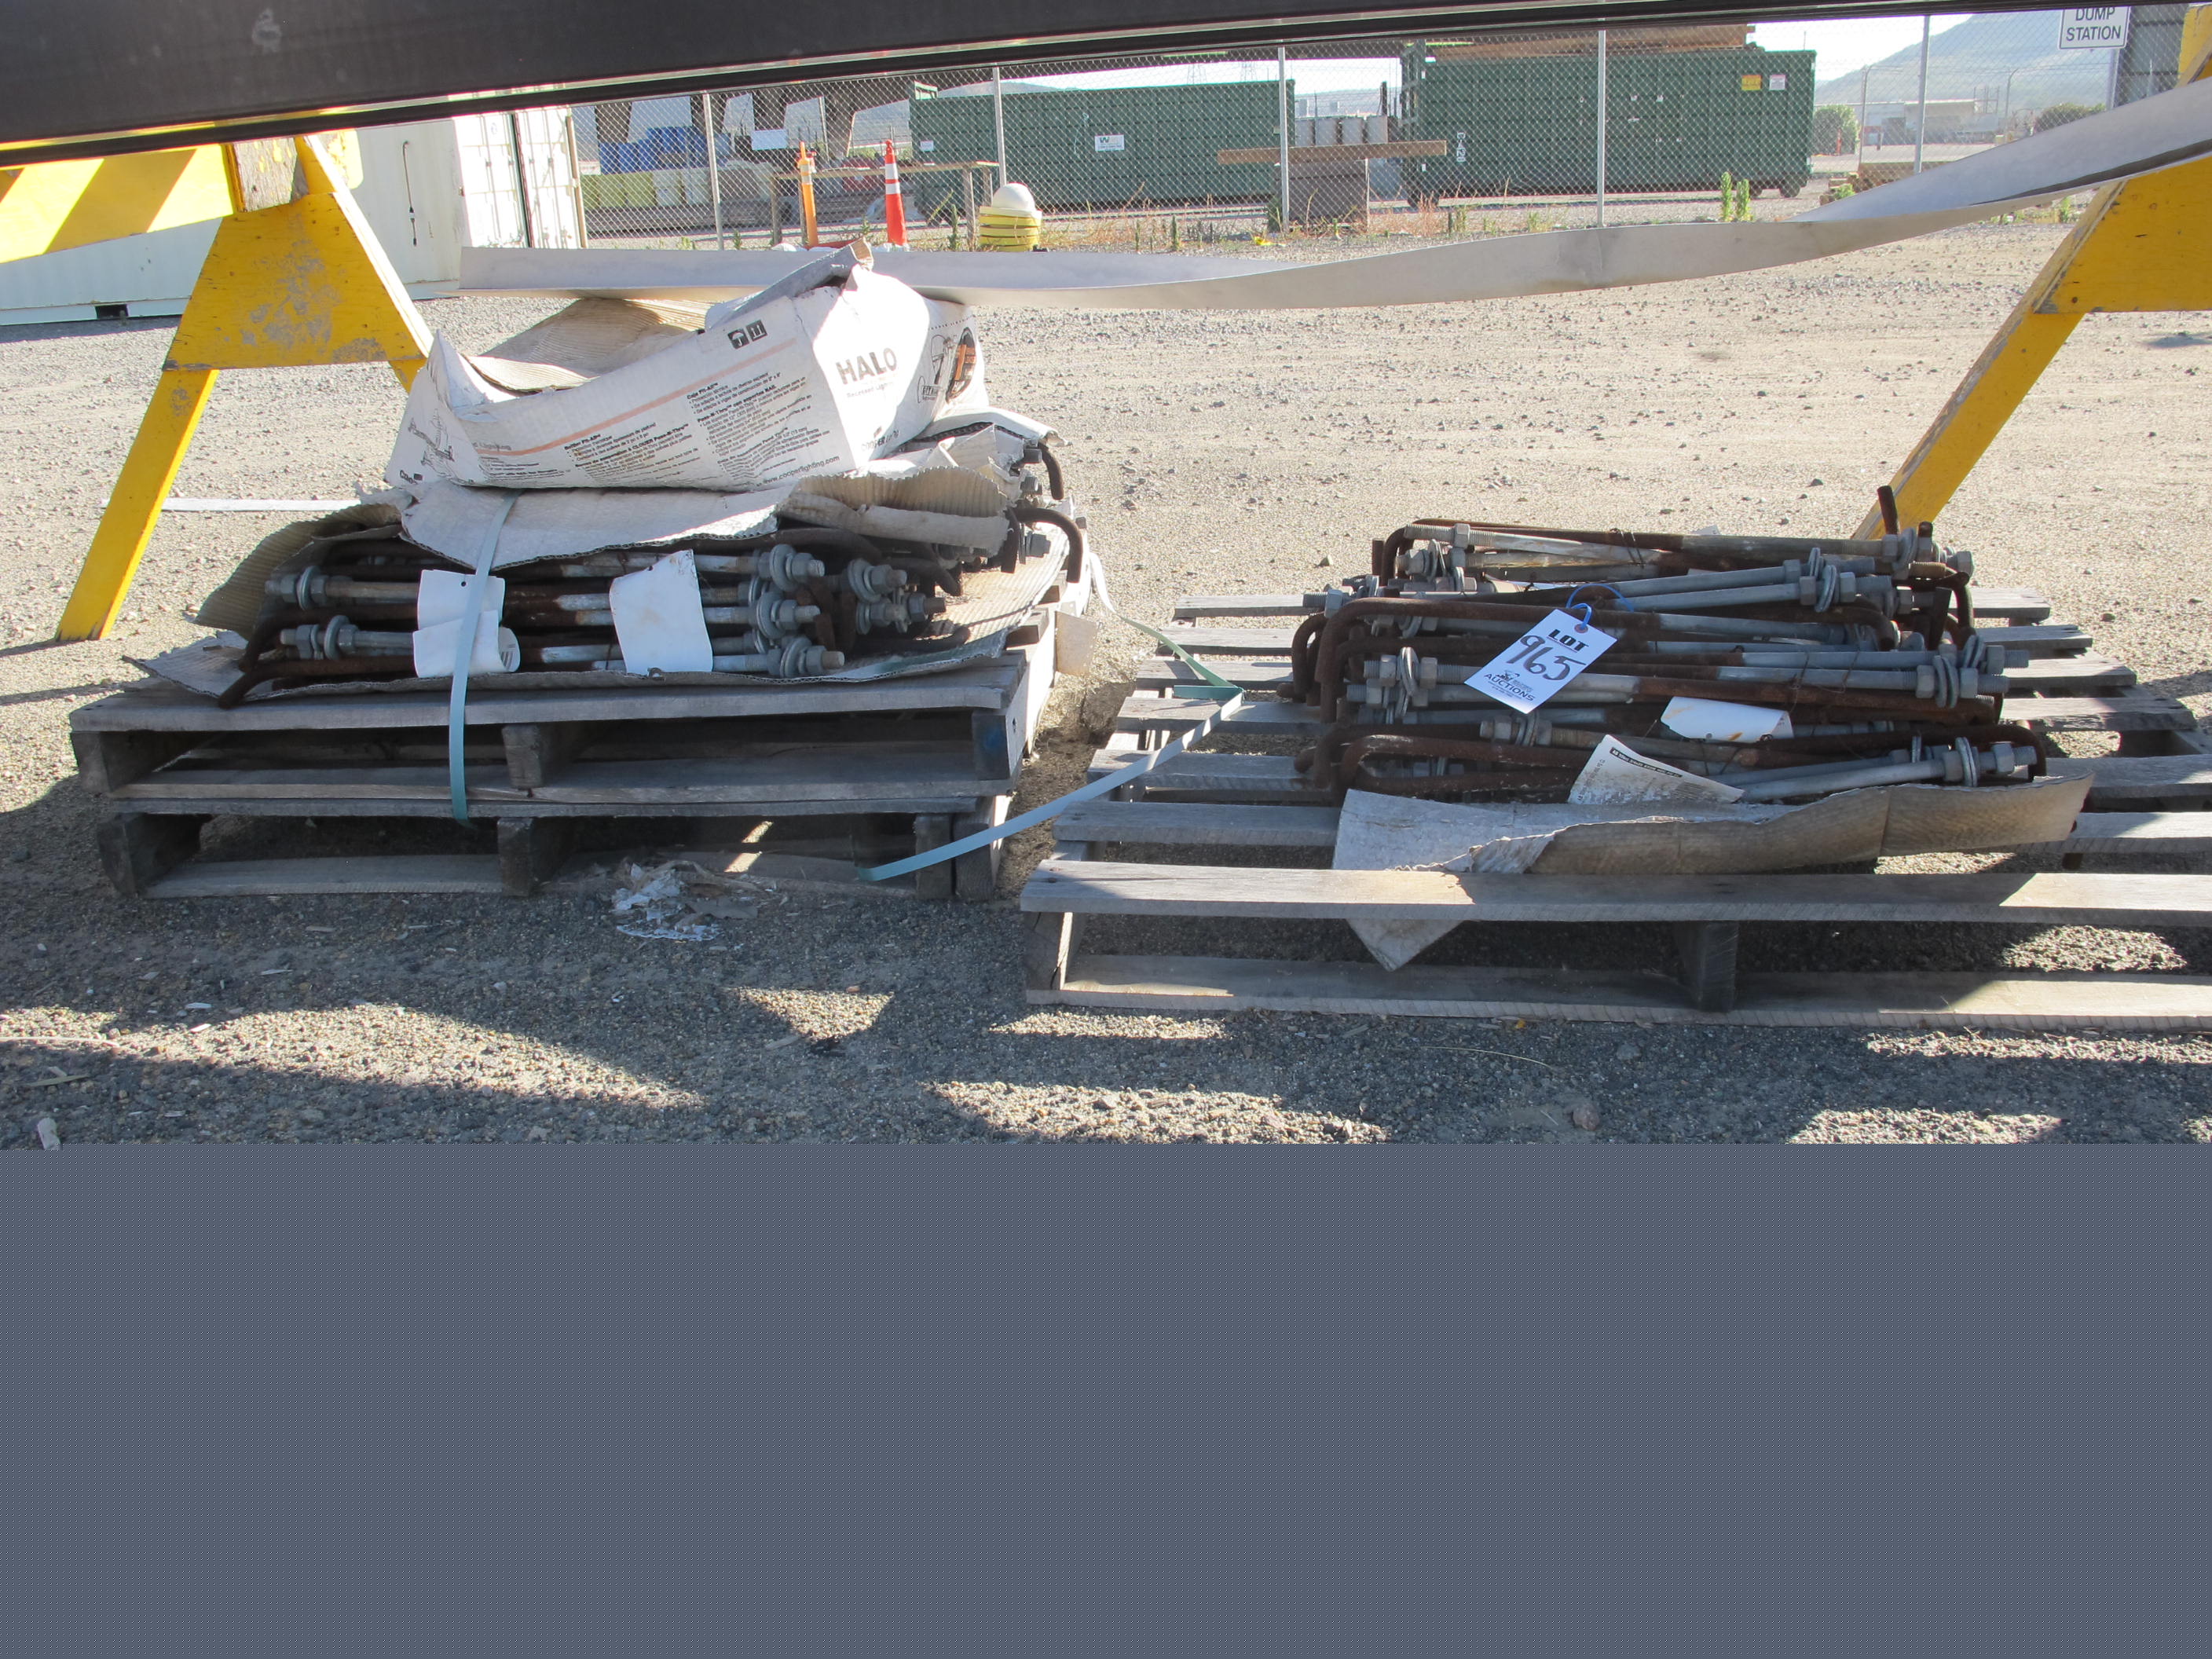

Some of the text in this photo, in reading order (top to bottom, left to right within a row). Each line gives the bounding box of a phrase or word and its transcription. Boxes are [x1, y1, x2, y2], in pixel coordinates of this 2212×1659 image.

[2075, 7, 2116, 21] DUMP
[2065, 25, 2122, 42] STATION
[835, 347, 897, 385] HALO
[1547, 628, 1589, 652] LOT
[1506, 635, 1587, 681] 965
[1483, 673, 1536, 701] AUCTIONS
